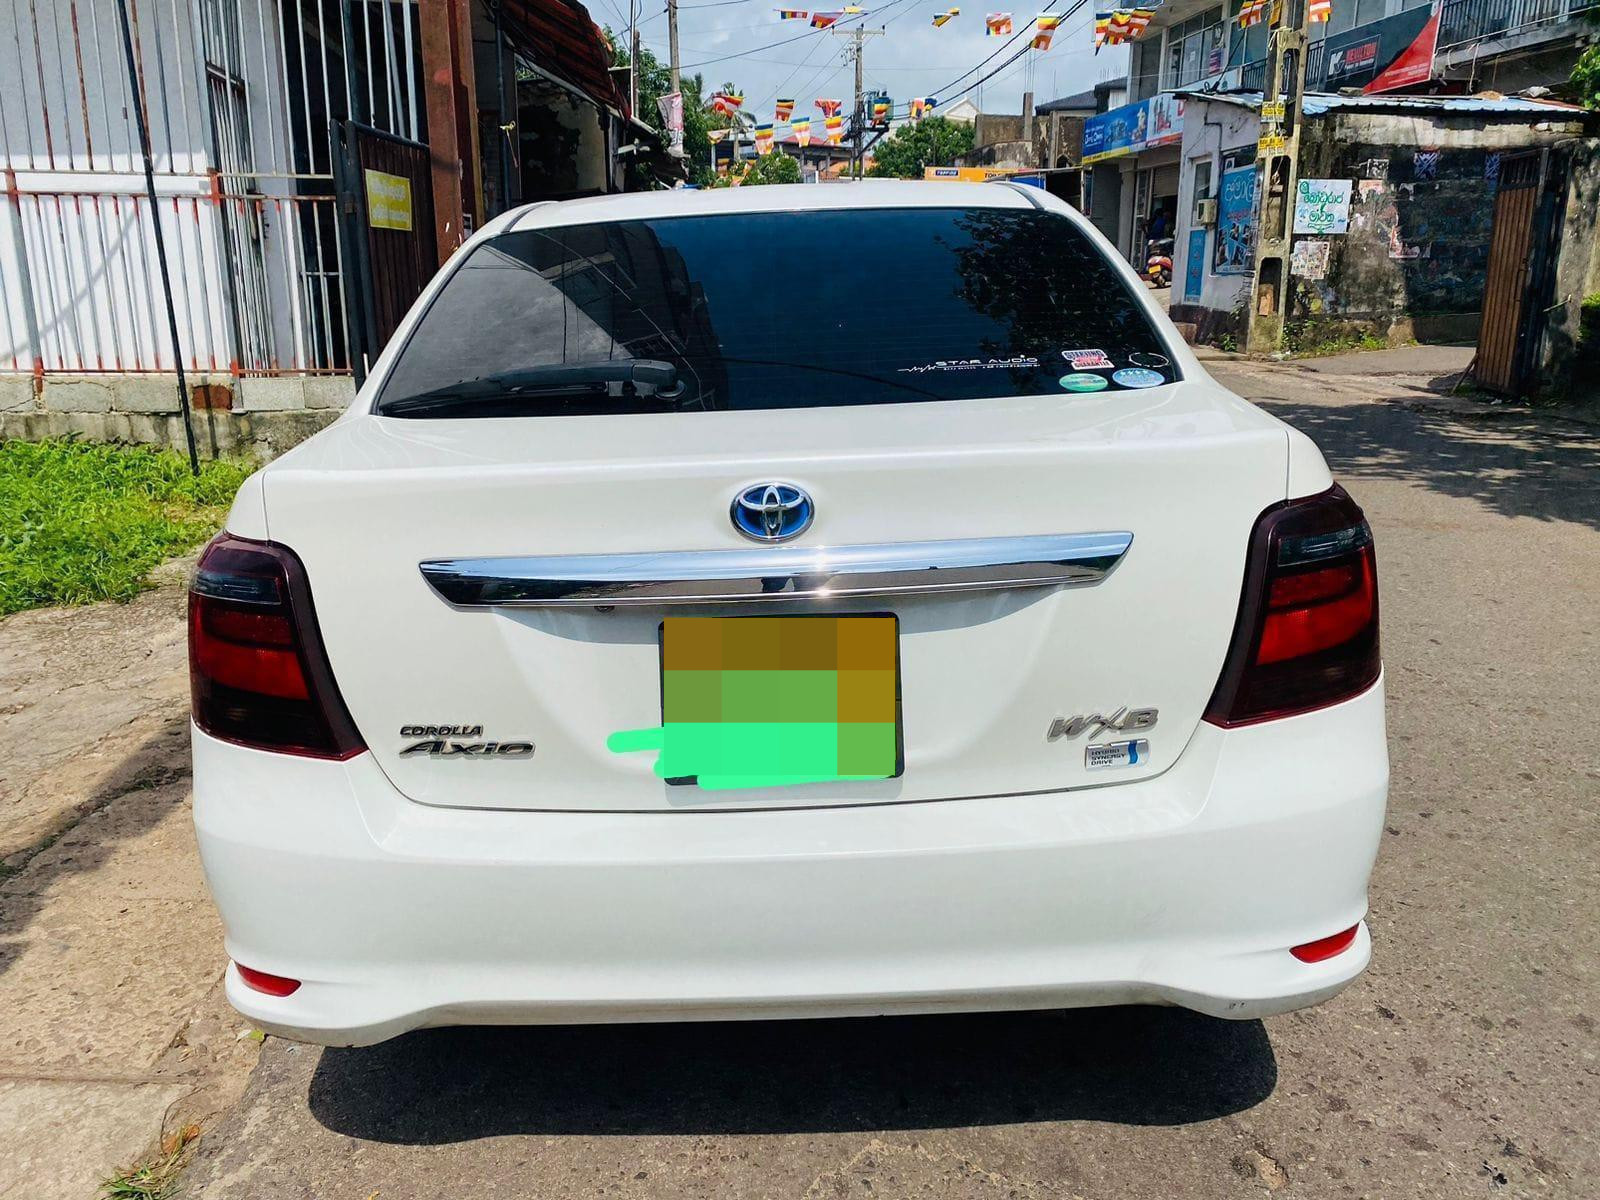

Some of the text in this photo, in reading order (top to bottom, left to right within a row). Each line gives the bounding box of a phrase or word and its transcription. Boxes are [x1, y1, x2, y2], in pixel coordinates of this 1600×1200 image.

[399, 726, 483, 736] COROLLA
[399, 740, 535, 758] Axio
[1091, 748, 1120, 756] HYBRID
[1091, 753, 1126, 761] SYNERGY
